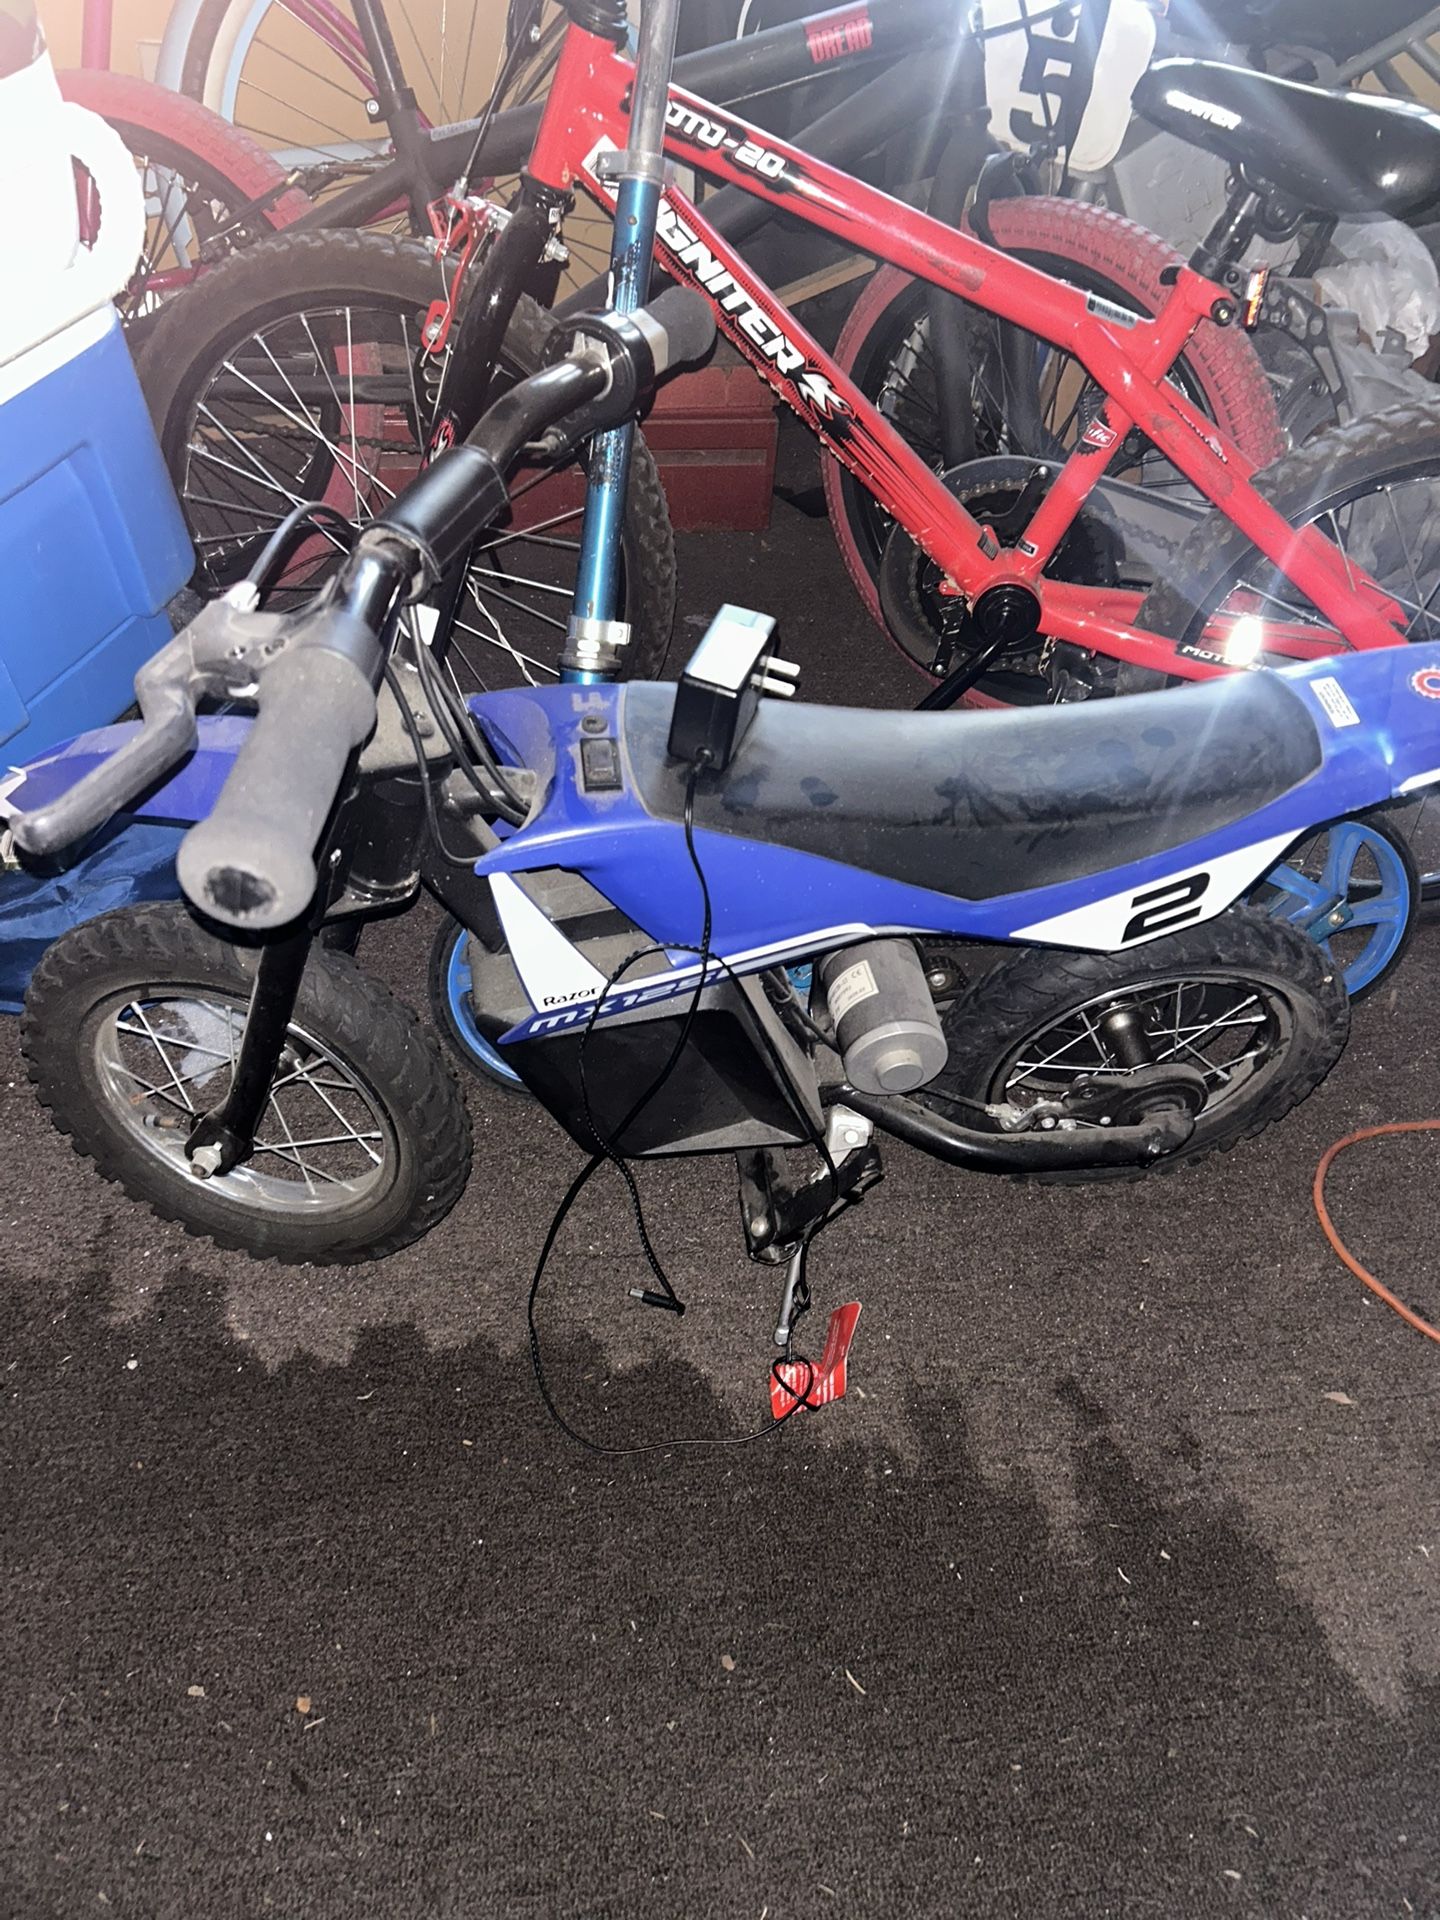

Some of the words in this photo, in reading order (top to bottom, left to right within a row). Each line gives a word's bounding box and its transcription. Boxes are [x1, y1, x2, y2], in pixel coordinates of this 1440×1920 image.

[1009, 34, 1074, 147] 5
[665, 101, 785, 178] OTO-20
[1121, 872, 1210, 944] 2
[543, 986, 599, 1007] Razor
